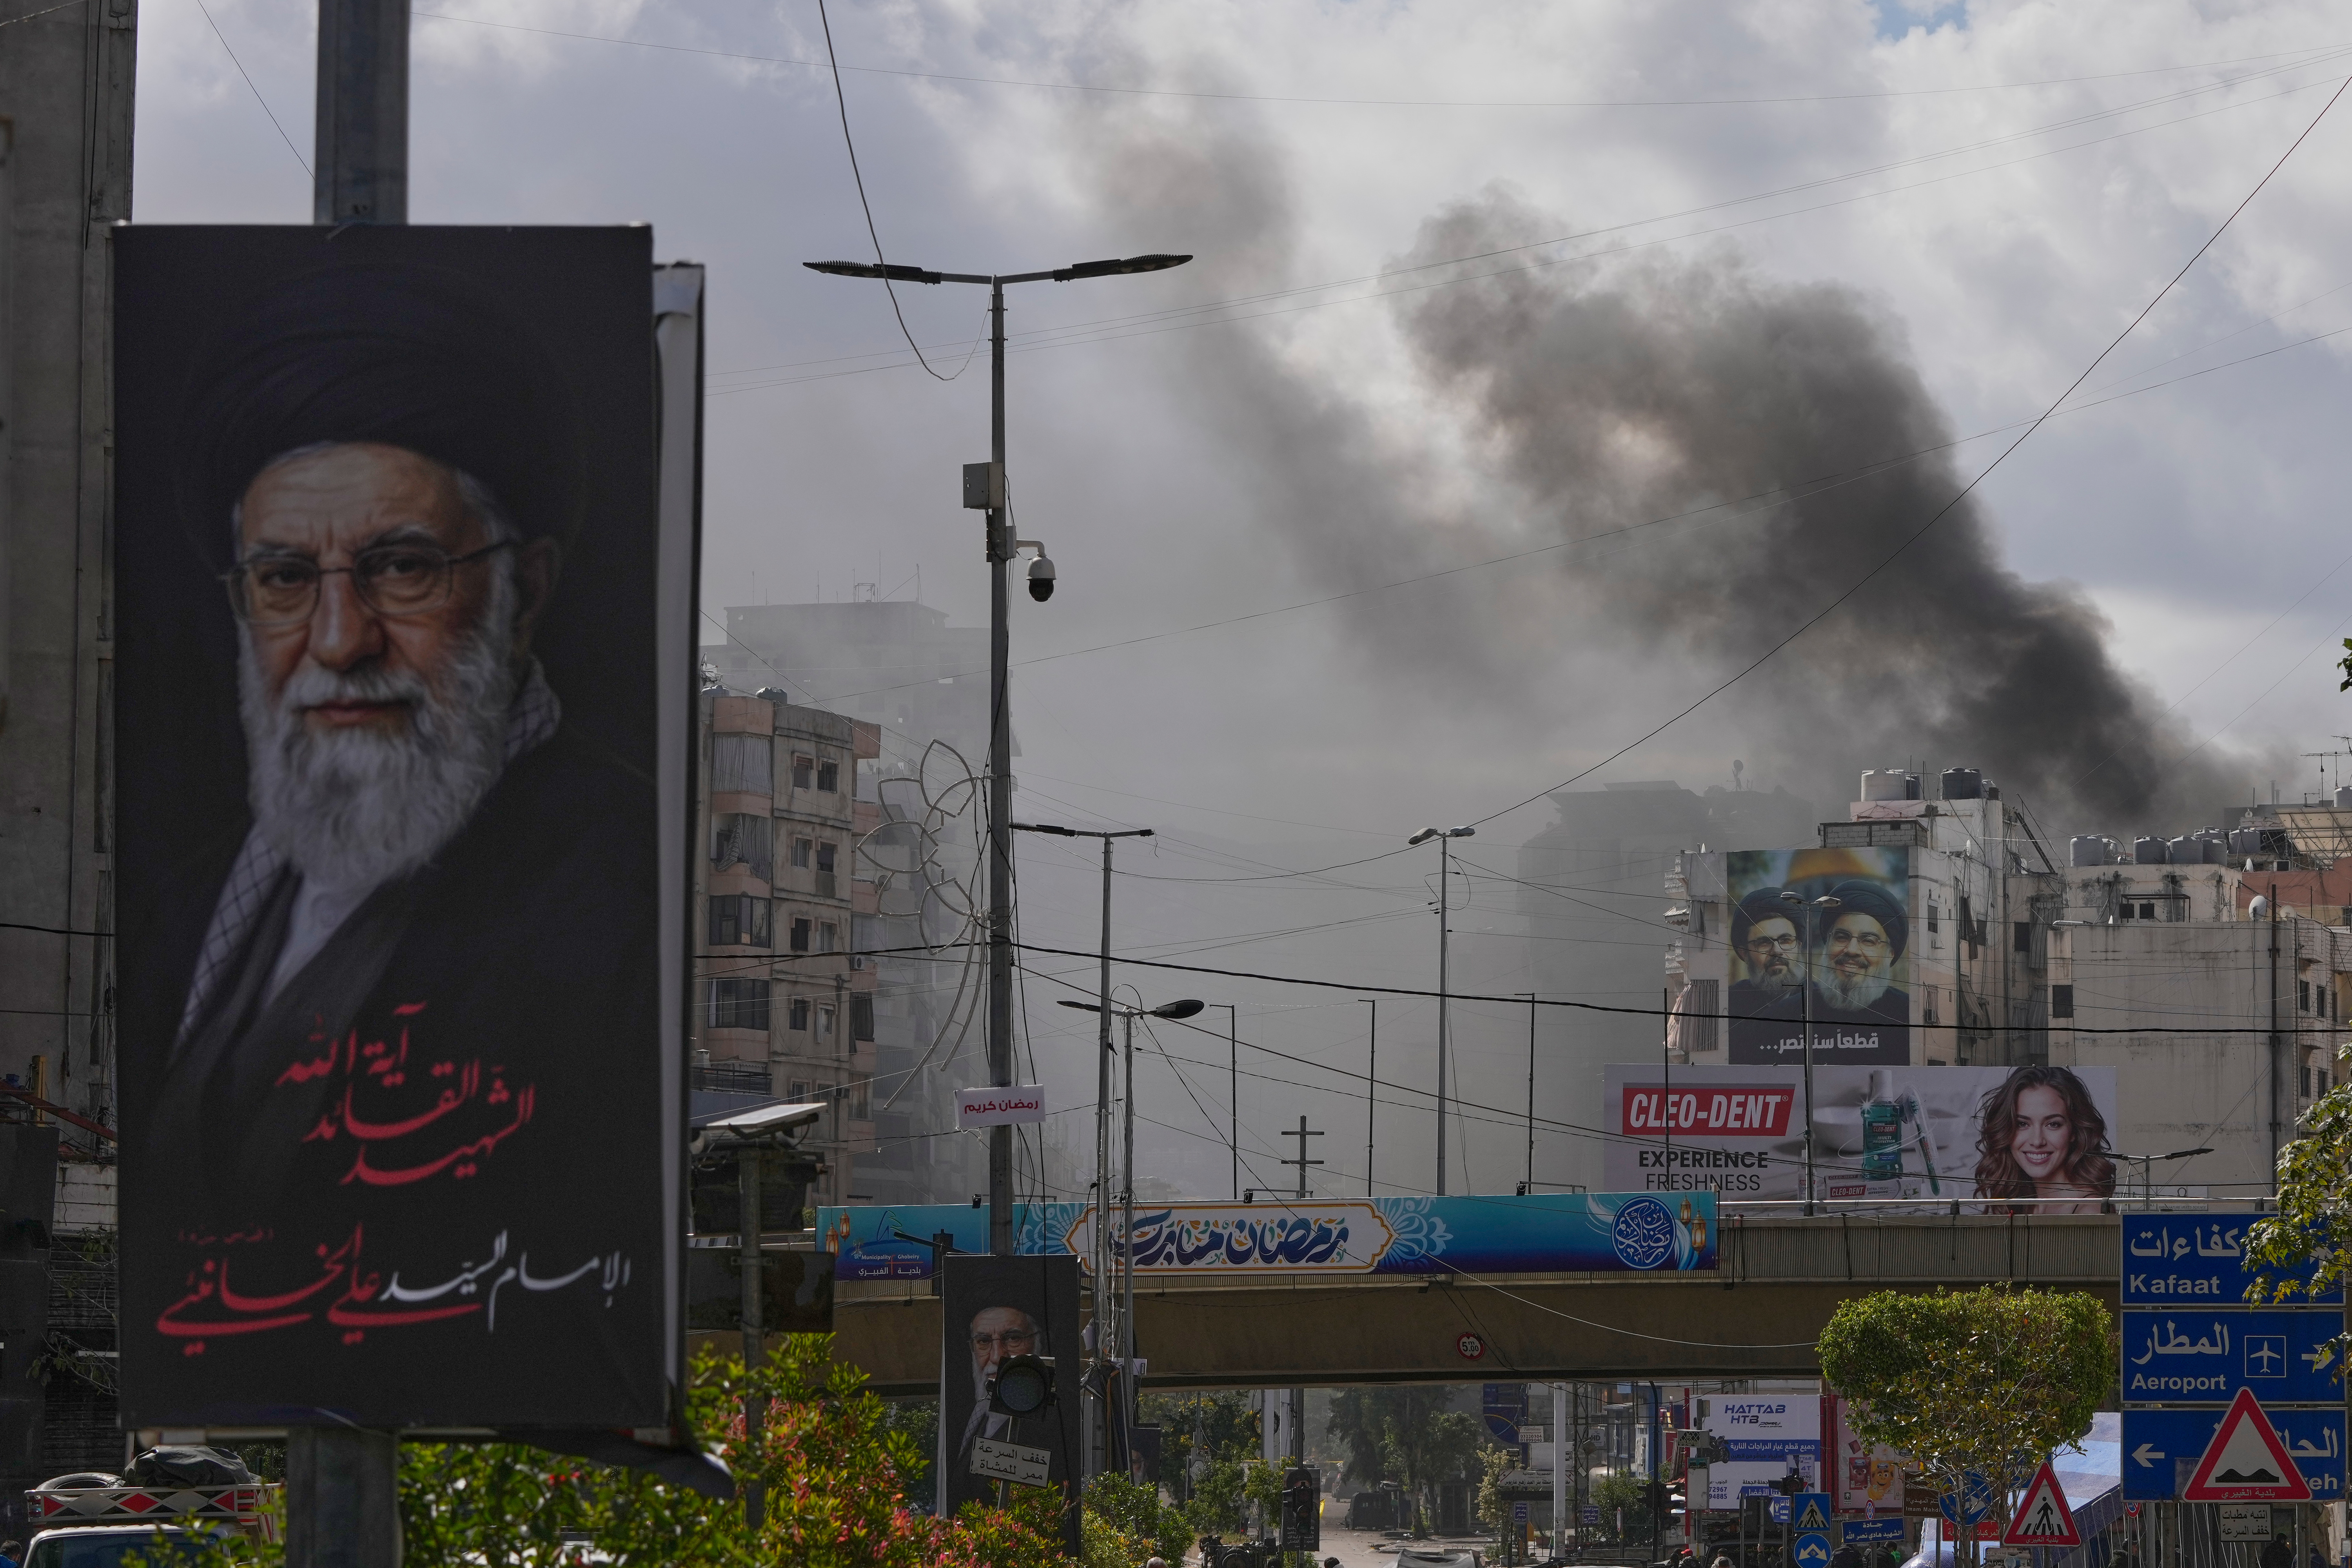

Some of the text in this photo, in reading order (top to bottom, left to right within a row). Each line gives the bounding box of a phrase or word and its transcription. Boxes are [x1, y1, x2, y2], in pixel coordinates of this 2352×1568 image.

[276, 1014, 357, 1085] الله
[302, 1059, 480, 1142] القائد
[964, 1099, 1038, 1114] رمضان كريم
[1639, 1151, 1768, 1168] EXPERIENCE
[1646, 1174, 1760, 1191] FRESHNESS
[1832, 1187, 1864, 1196] CLEO-DENT
[1225, 1217, 1349, 1264] رمضان
[2131, 1224, 2240, 1261] كفاءات
[858, 1267, 921, 1276] بلدية الغبيري
[2130, 1274, 2220, 1294] Kafaat
[2131, 1319, 2229, 1365] المطار
[2131, 1373, 2226, 1394] Aeroport
[1725, 1405, 1786, 1414] HATTAB
[1731, 1415, 1759, 1423] HTB
[978, 1441, 1047, 1465] خفف السرعة
[1730, 1443, 1746, 1451] النارية
[1748, 1443, 1771, 1451] الدراجات
[1773, 1443, 1783, 1451] غيار
[1785, 1443, 1798, 1452] قطع
[980, 1459, 1016, 1474] للمشاة
[2221, 1488, 2275, 1499] بلدية الغبيري
[2222, 1509, 2247, 1522] مطبات
[1846, 1530, 1855, 1539] الله
[1869, 1532, 1882, 1540] هادي
[1883, 1529, 1902, 1538] الشهيد
[2222, 1524, 2269, 1538] خفف السرعة
